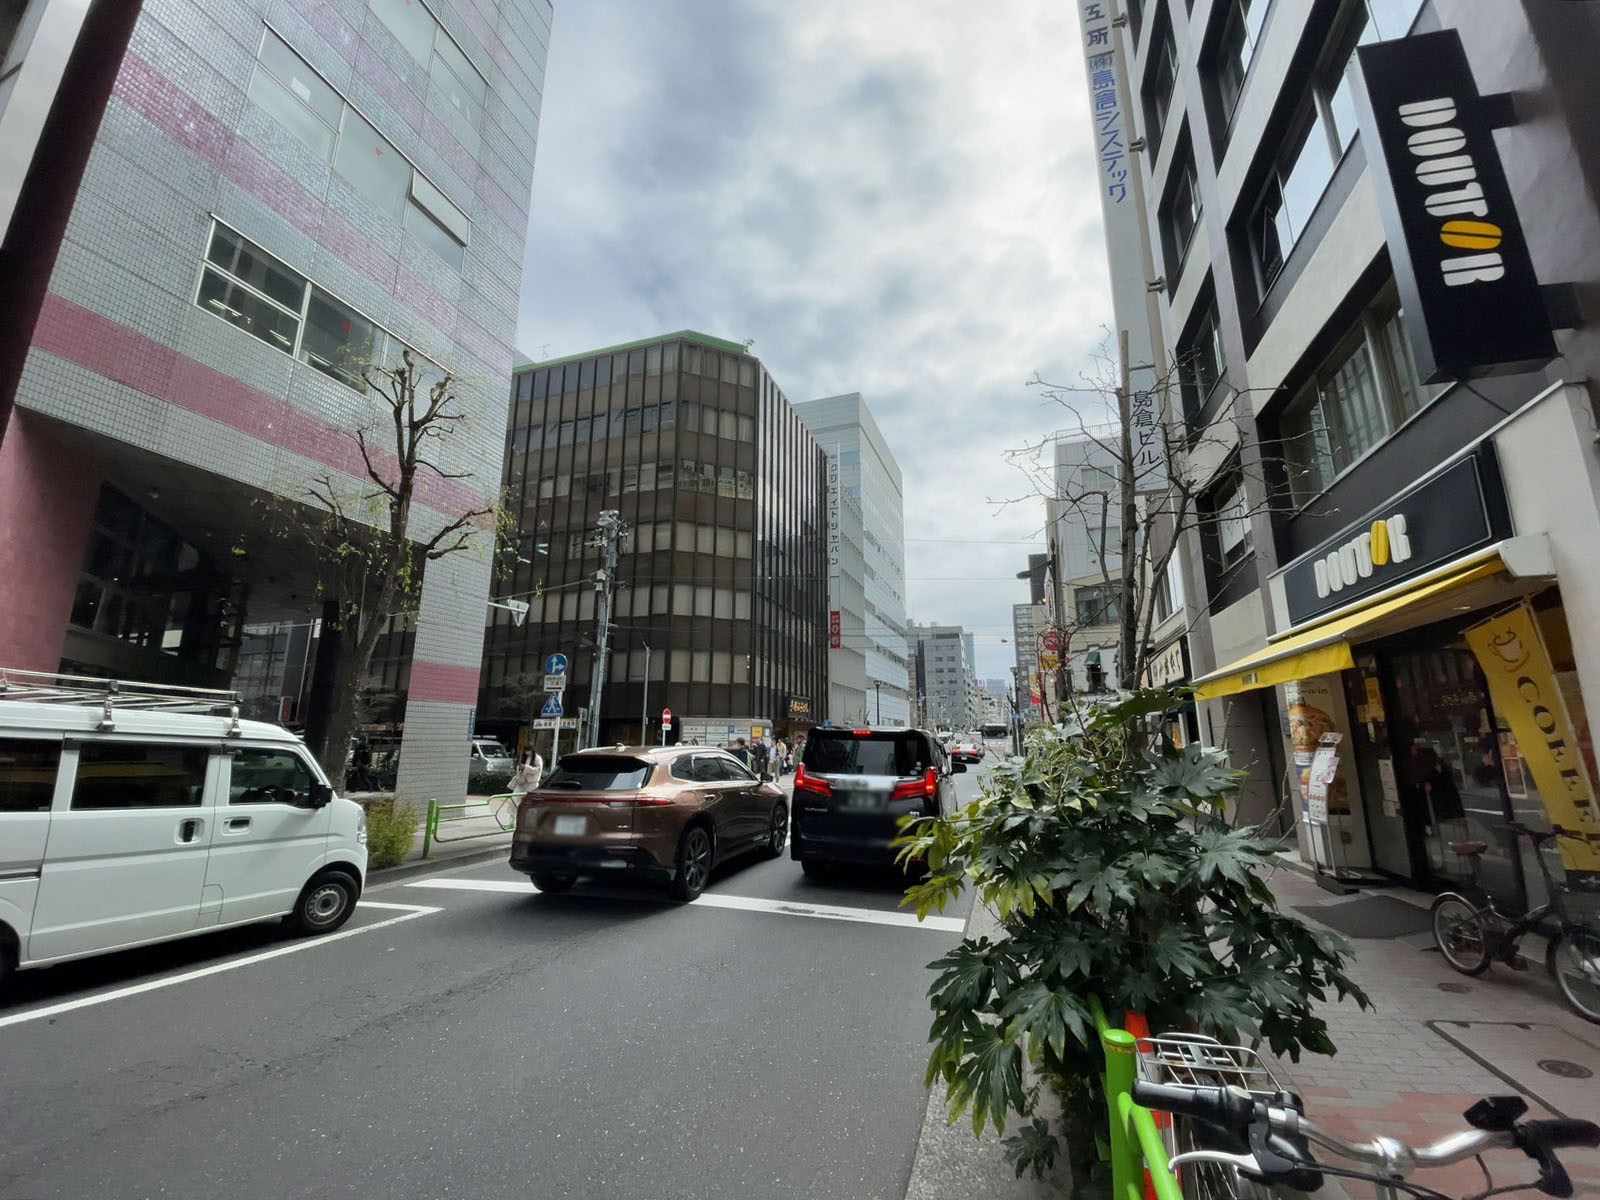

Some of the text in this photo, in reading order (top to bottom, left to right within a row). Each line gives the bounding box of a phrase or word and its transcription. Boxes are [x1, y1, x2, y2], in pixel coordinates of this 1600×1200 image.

[1398, 97, 1505, 287] DOUTOR
[1133, 390, 1159, 466] 島倉ビル
[1313, 513, 1412, 599] DOUTOR
